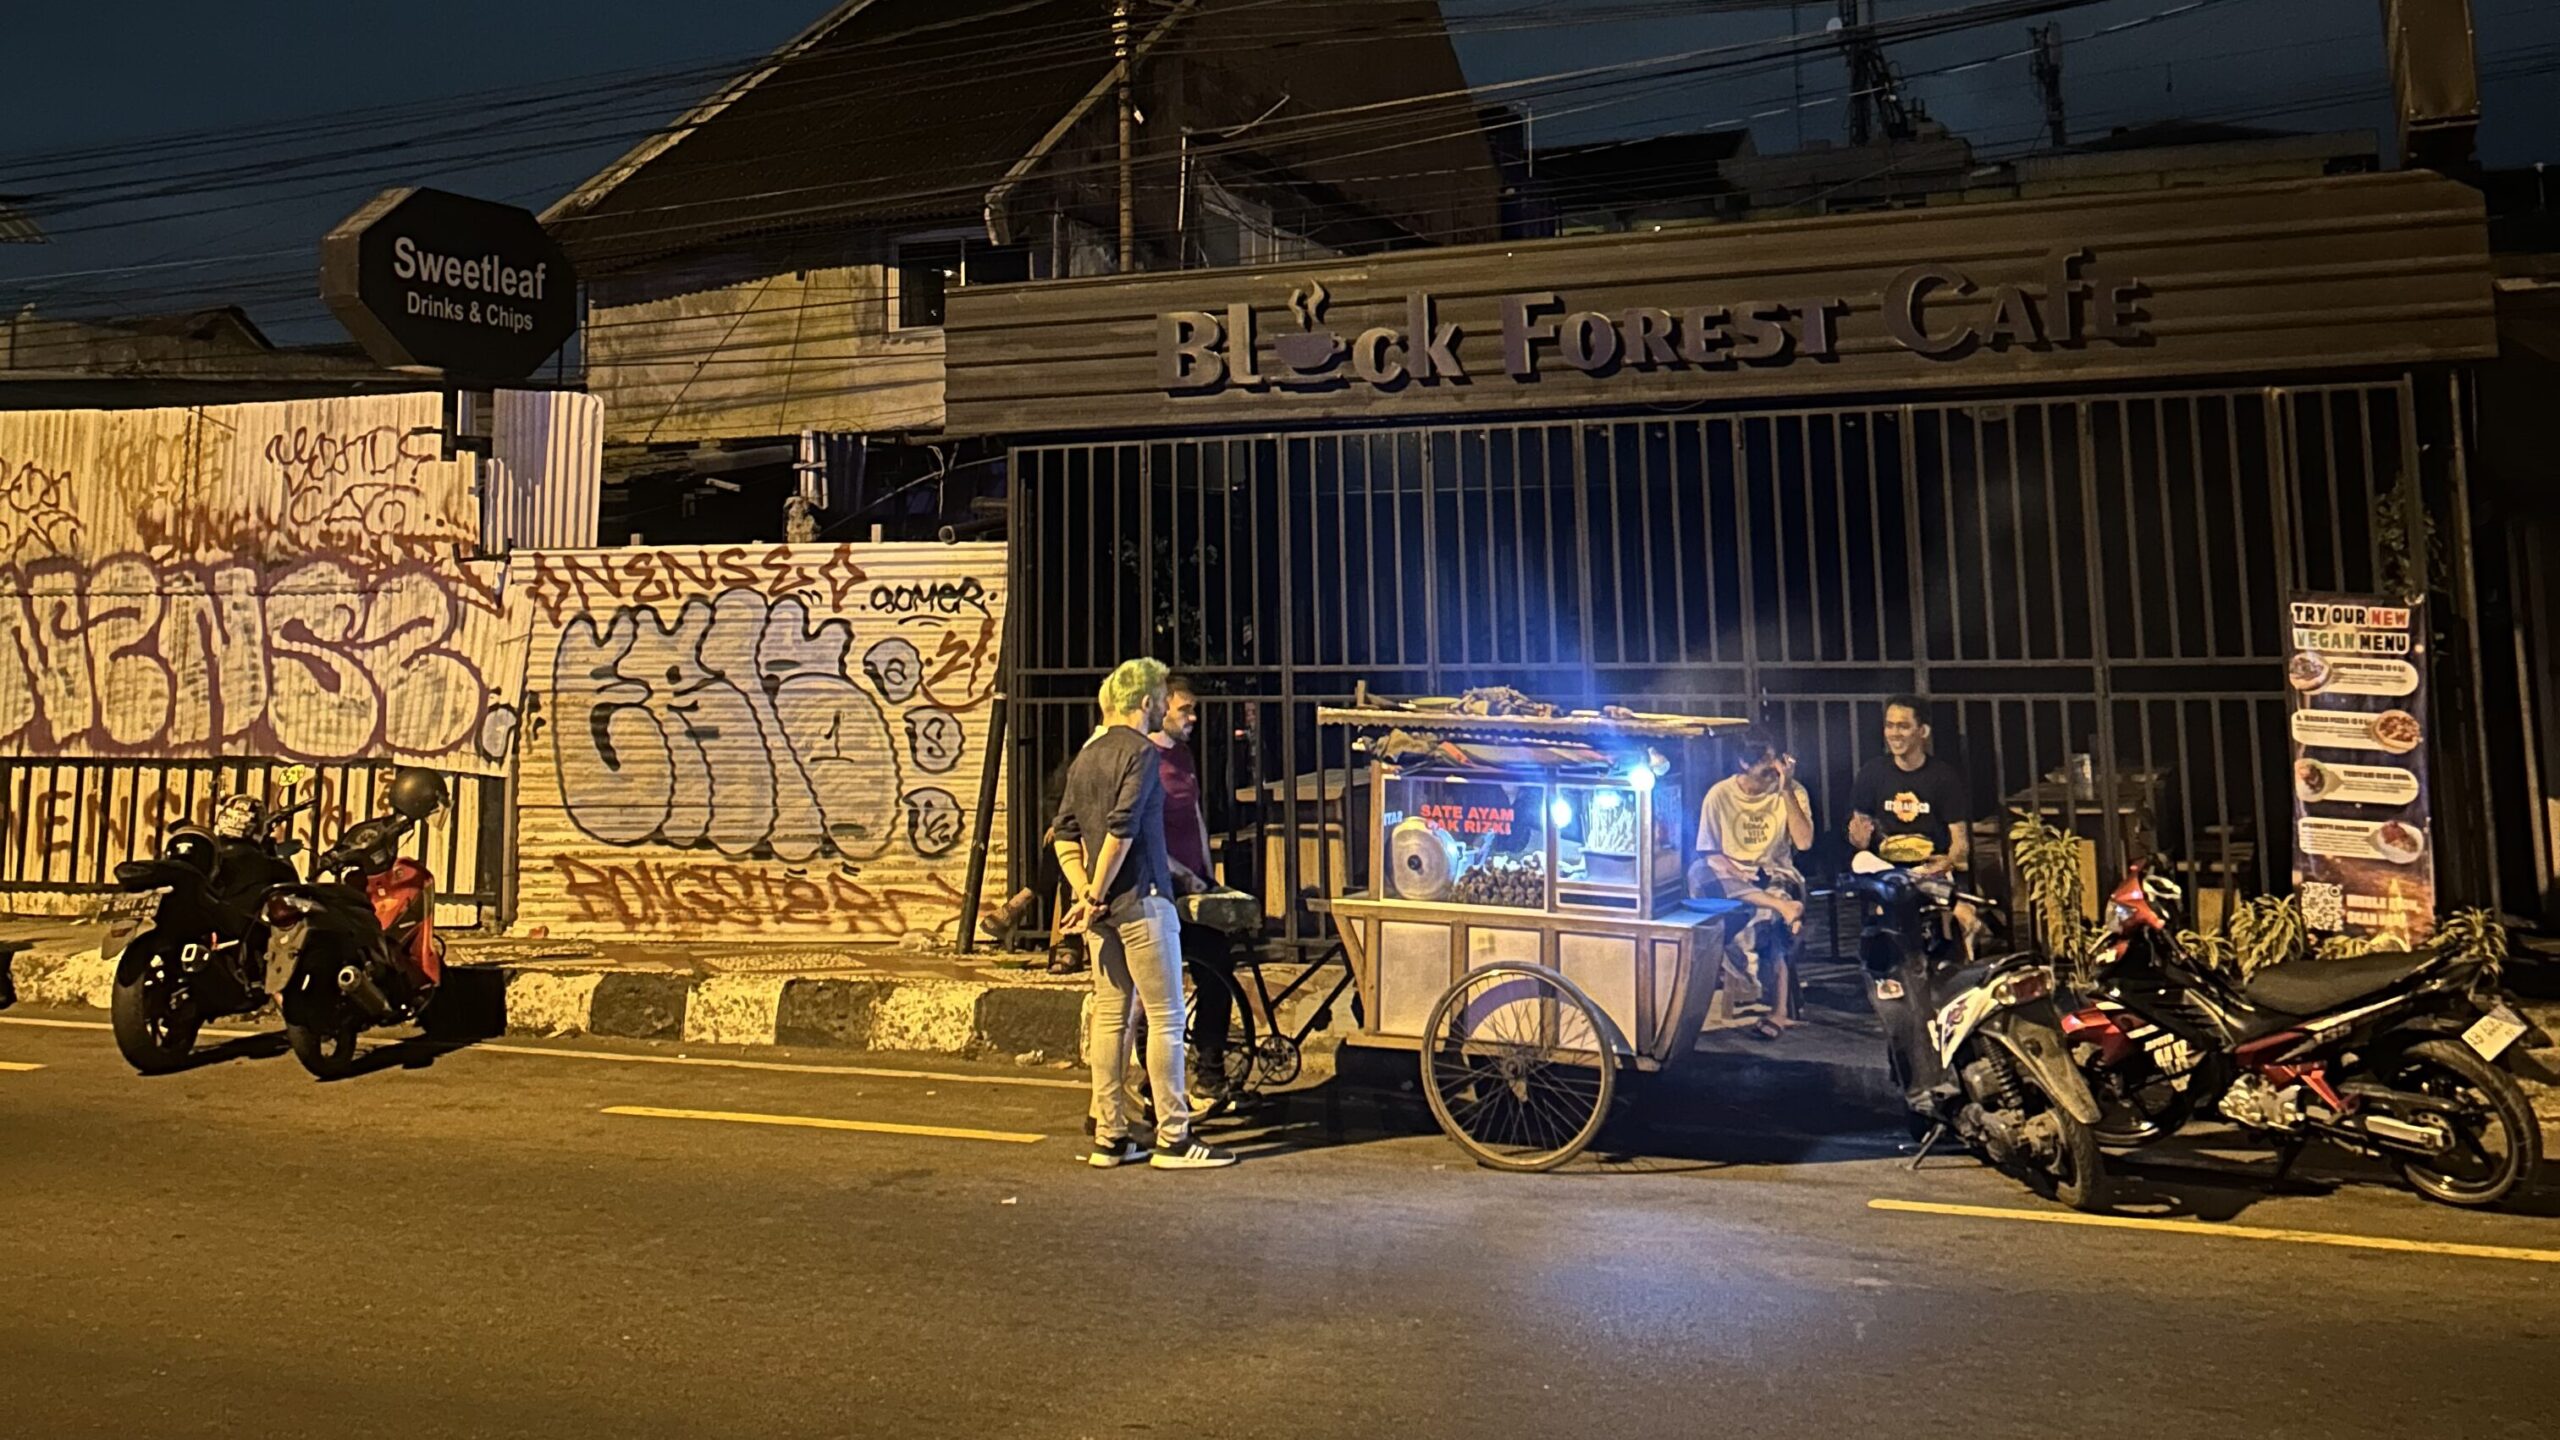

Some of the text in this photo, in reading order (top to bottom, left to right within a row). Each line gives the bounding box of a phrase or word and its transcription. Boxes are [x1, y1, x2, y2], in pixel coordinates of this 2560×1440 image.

[394, 236, 547, 300] Sweetleaf
[407, 290, 533, 334] Drinks & Chips
[1156, 284, 1465, 388] Blck
[2293, 604, 2408, 627] TRY OUR NEW
[2296, 626, 2407, 653] VEGAN MENU
[1420, 804, 1515, 822] SATE AYAM
[1464, 820, 1512, 835] RIZKI
